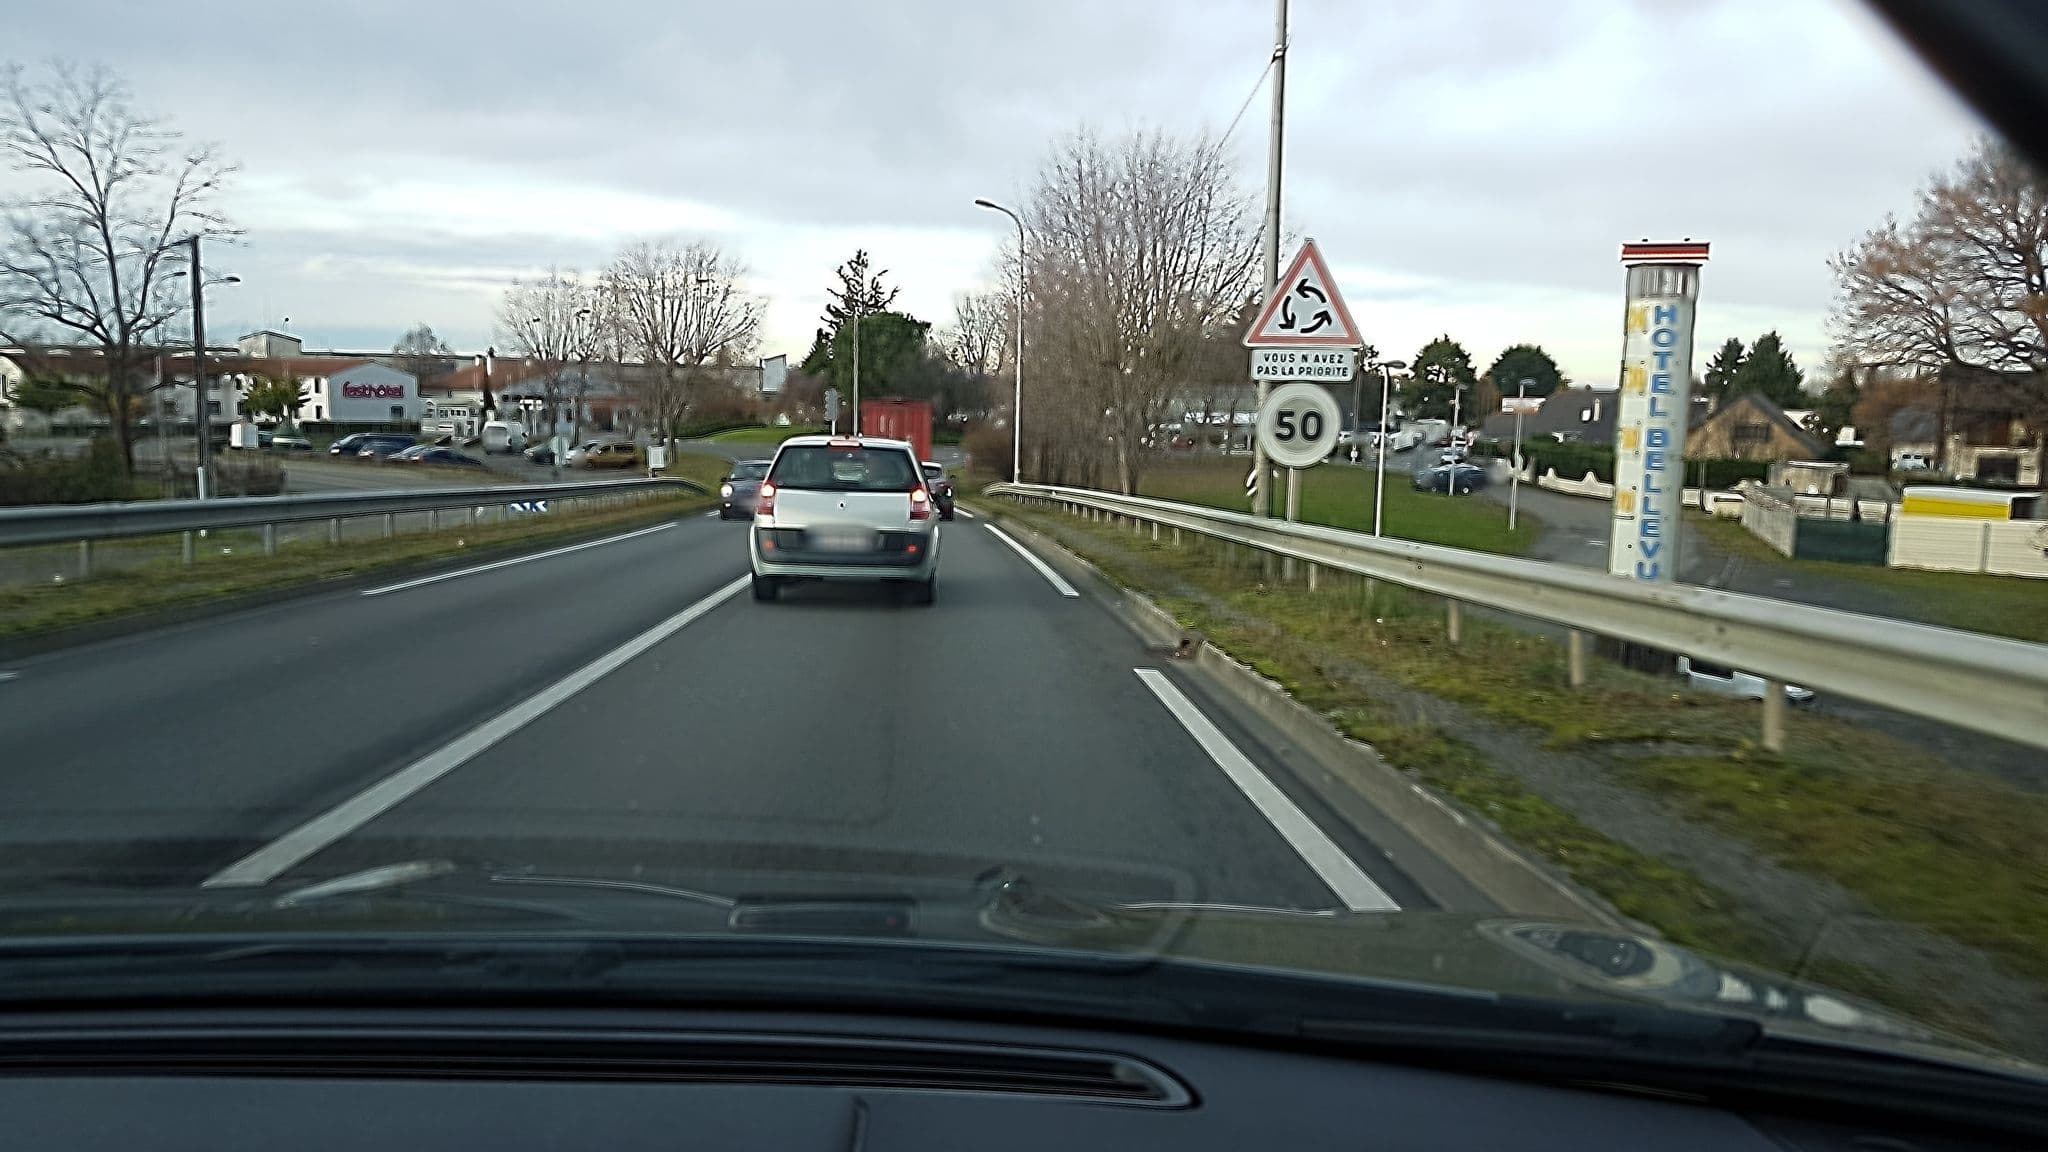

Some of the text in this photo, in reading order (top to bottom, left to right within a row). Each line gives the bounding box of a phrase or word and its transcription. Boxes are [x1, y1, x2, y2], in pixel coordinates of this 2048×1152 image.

[1263, 353, 1296, 364] VOUS
[1648, 304, 1678, 418] HOTEL
[1256, 365, 1349, 377] PAS LA PRIORITE
[1274, 410, 1323, 442] 50
